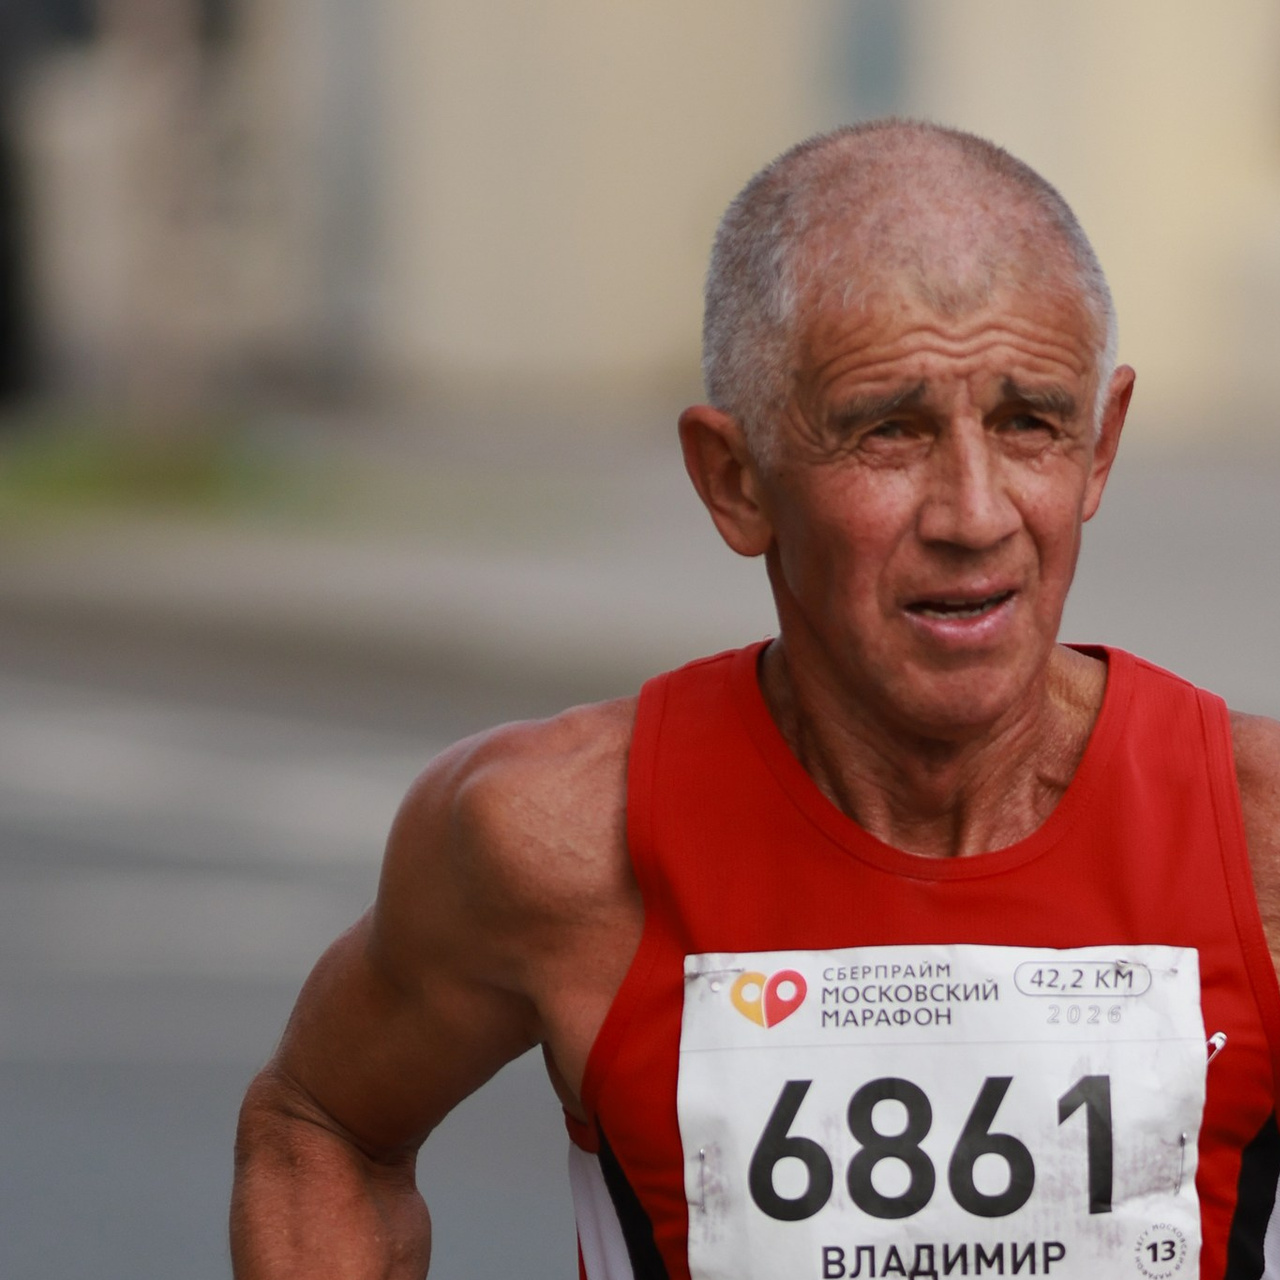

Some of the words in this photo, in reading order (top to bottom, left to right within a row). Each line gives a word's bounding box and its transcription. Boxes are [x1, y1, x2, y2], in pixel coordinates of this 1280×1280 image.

[823, 962, 952, 982] СБЕРПРАЙМ
[1030, 968, 1086, 993] 42,2
[1094, 967, 1134, 990] КМ
[821, 977, 1000, 1005] МОСКОВСКИЙ
[821, 1006, 952, 1029] МАРАФОН
[1046, 1004, 1123, 1025] 2026
[748, 1073, 1114, 1222] 6861
[1145, 1239, 1177, 1264] 13
